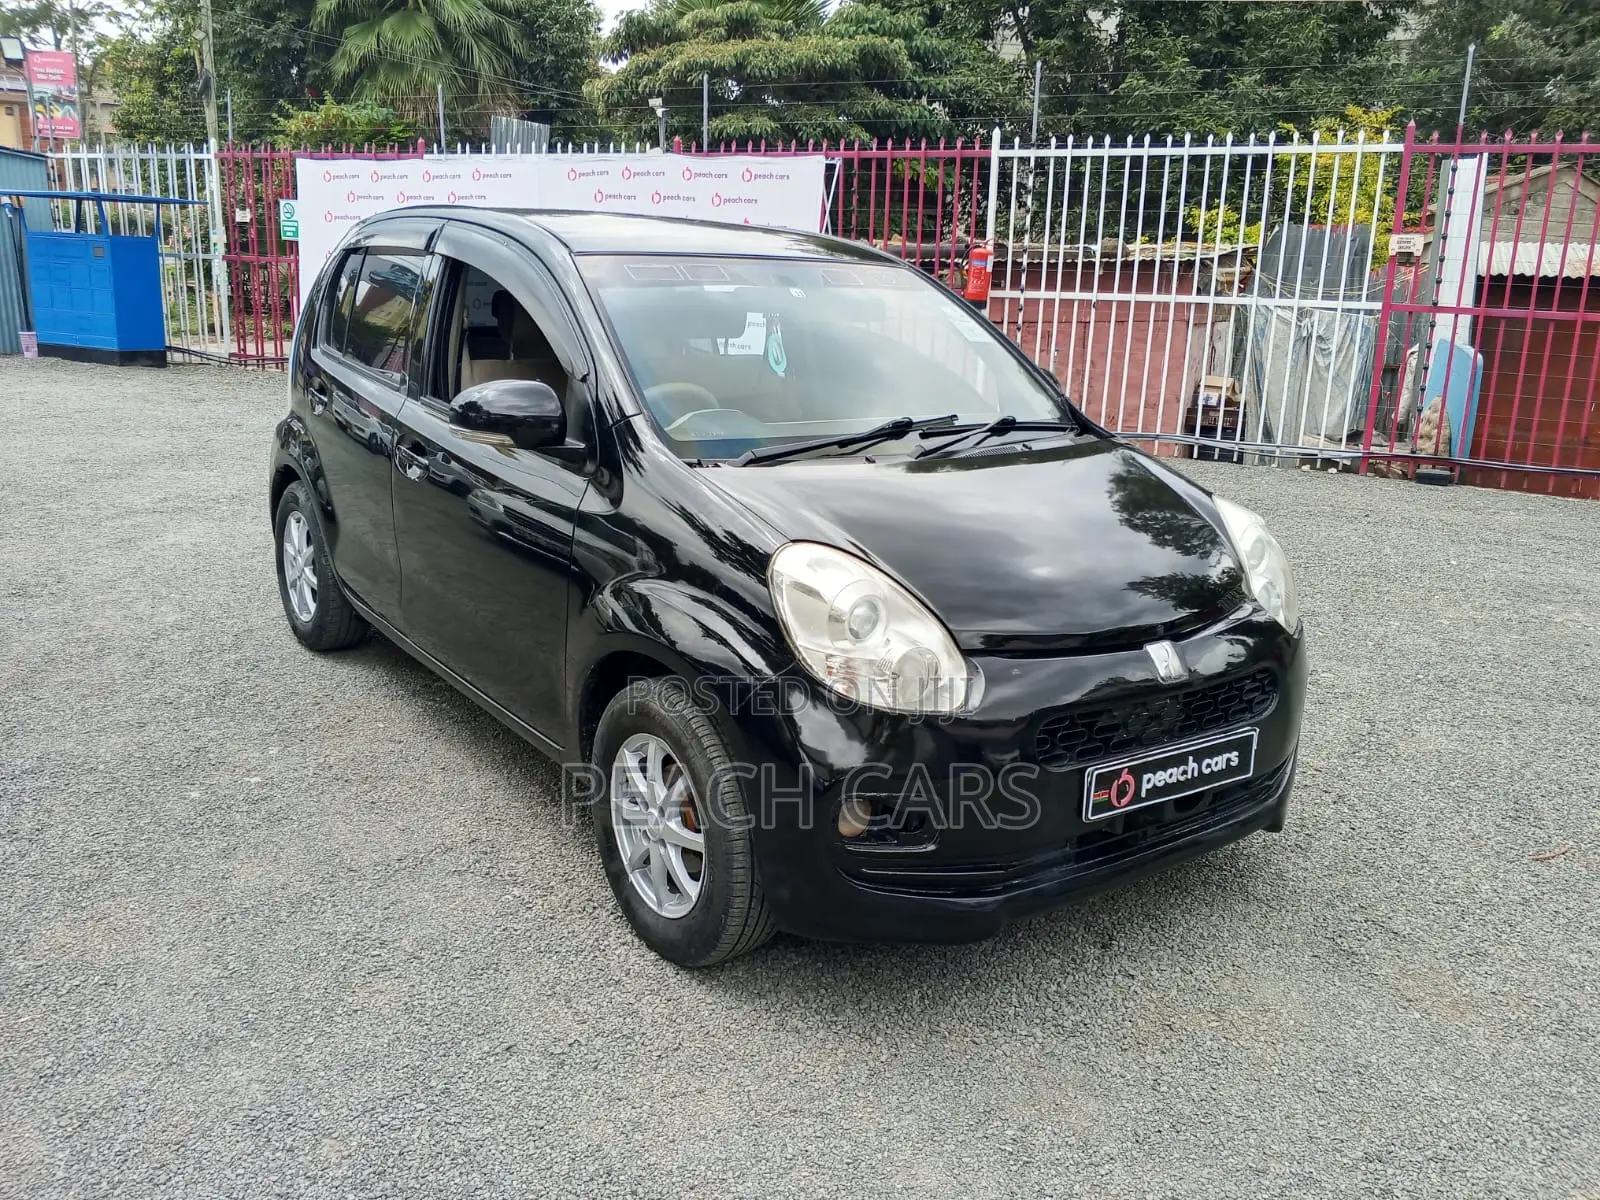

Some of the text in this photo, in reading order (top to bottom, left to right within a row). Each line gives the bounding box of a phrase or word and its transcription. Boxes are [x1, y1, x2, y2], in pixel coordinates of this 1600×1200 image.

[482, 172, 498, 180] peach
[578, 169, 595, 179] peach
[633, 169, 651, 179] peach
[694, 171, 713, 179] peach
[754, 172, 774, 180] peach
[406, 193, 422, 201] peach
[605, 193, 622, 201] peach
[663, 193, 681, 202] peach
[723, 196, 742, 205] peach
[1140, 750, 1239, 798] peach cars
